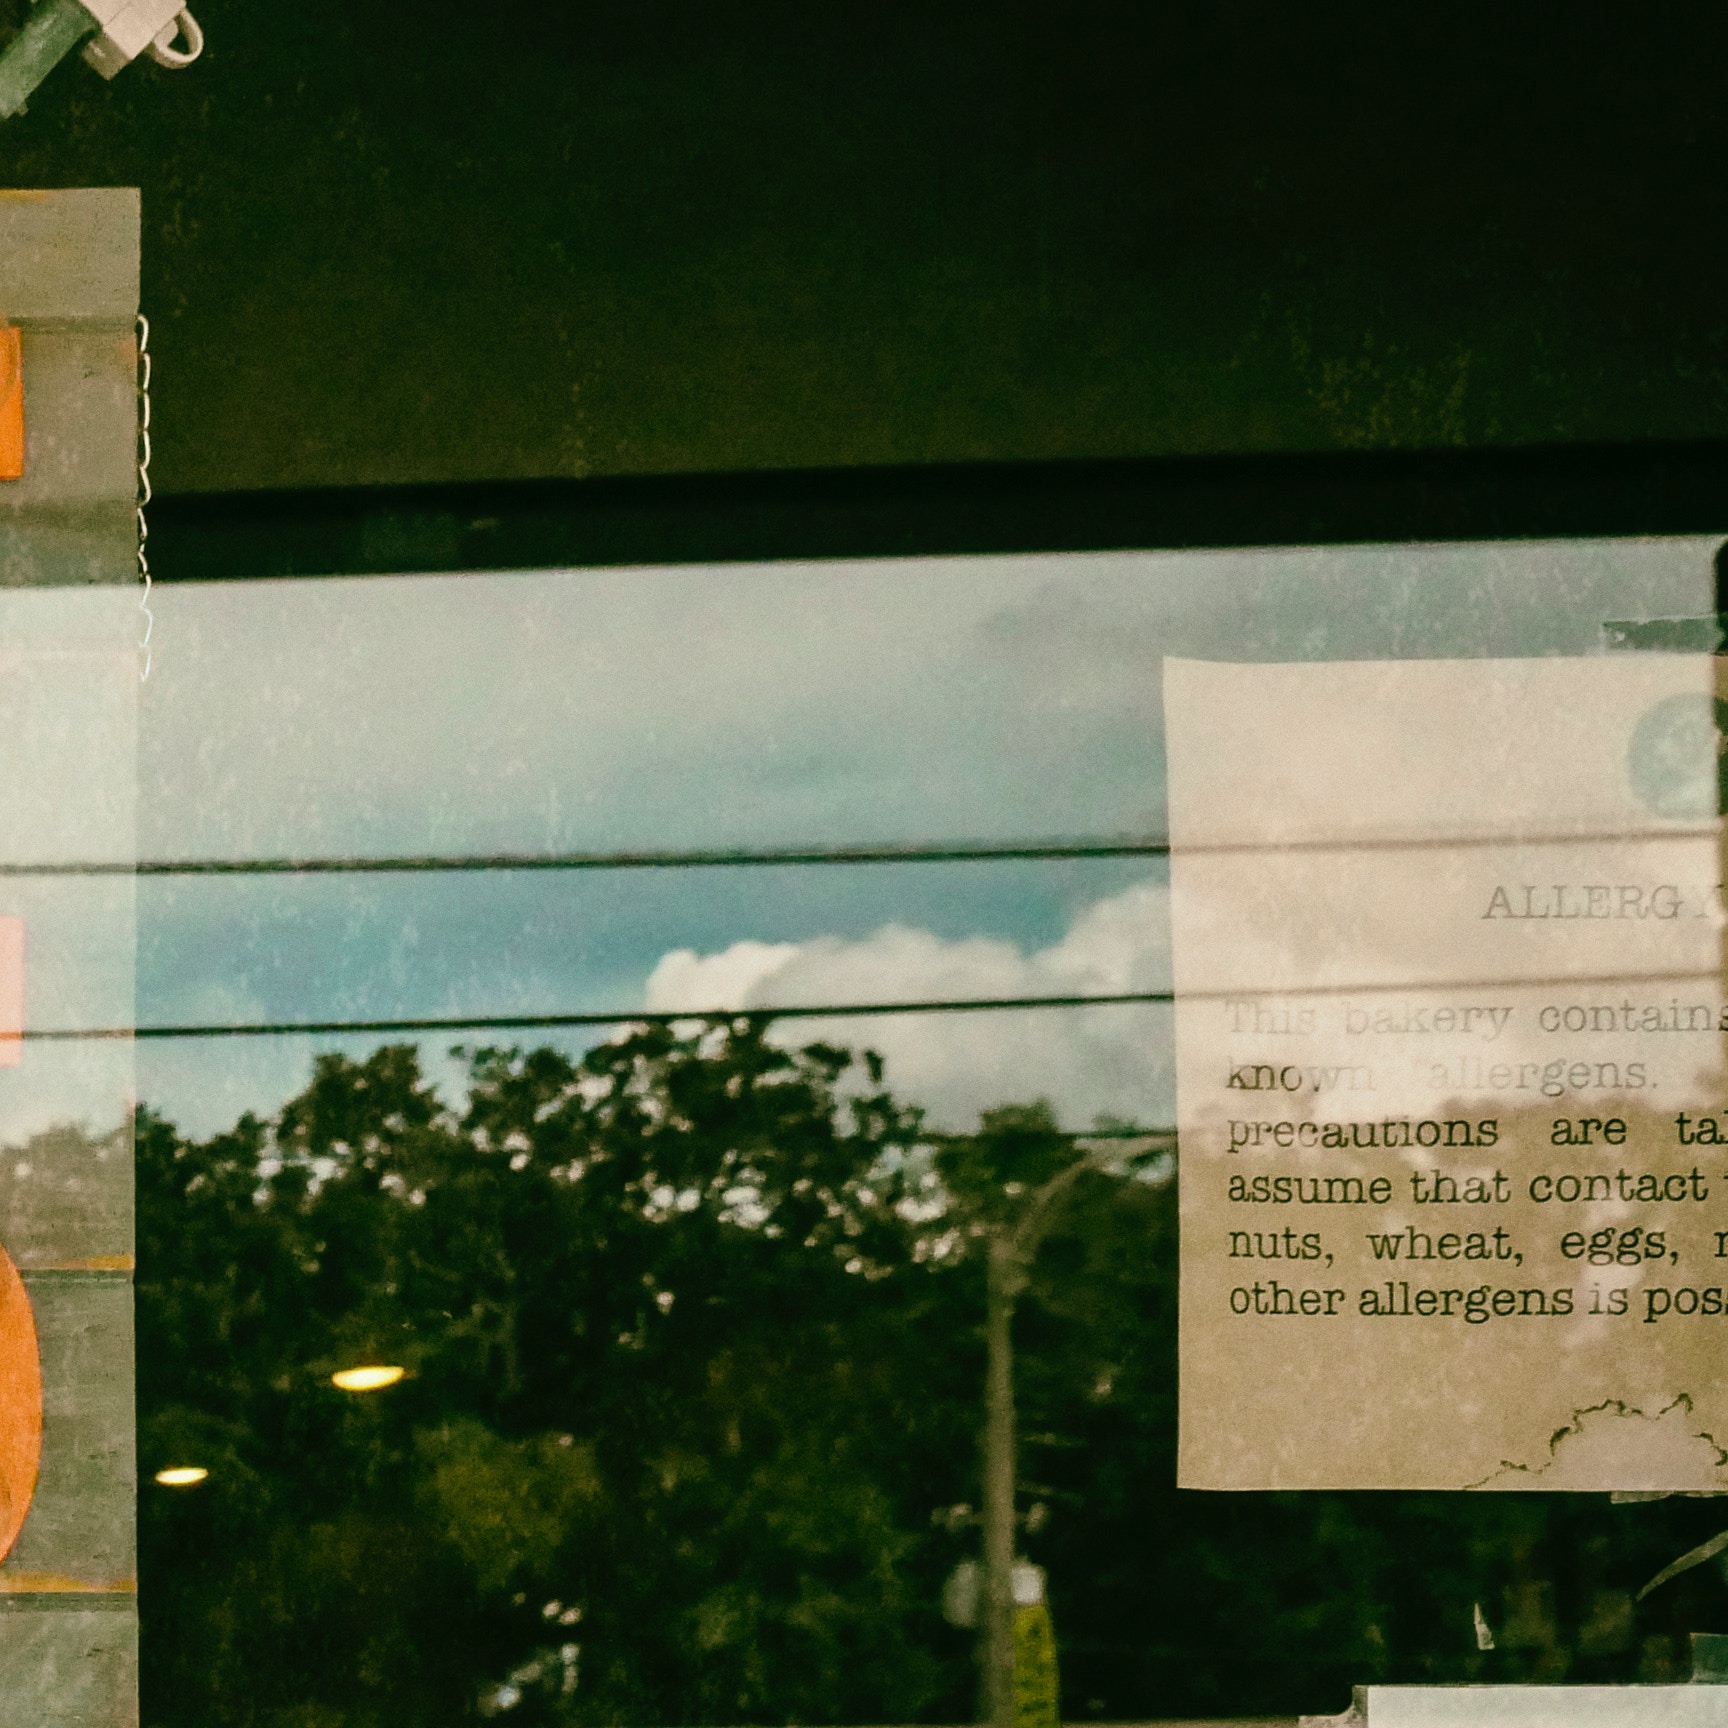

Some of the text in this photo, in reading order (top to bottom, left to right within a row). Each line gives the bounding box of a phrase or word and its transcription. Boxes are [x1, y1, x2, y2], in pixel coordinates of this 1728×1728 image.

[1481, 883, 1719, 921] ALLERG
[1225, 1000, 1317, 1034] This
[1344, 1000, 1514, 1042] bakery
[1226, 1054, 1659, 1097] known allergens.
[1227, 1113, 1500, 1153] precautions
[1550, 1115, 1628, 1147] are
[1228, 1165, 1710, 1205] assume that contact
[1228, 1227, 1335, 1268] nuts,
[1365, 1225, 1524, 1267] wheat,
[1559, 1226, 1680, 1267] eggs,
[1228, 1280, 1346, 1317] other
[1358, 1280, 1575, 1324] allergens
[1587, 1282, 1630, 1316] is
